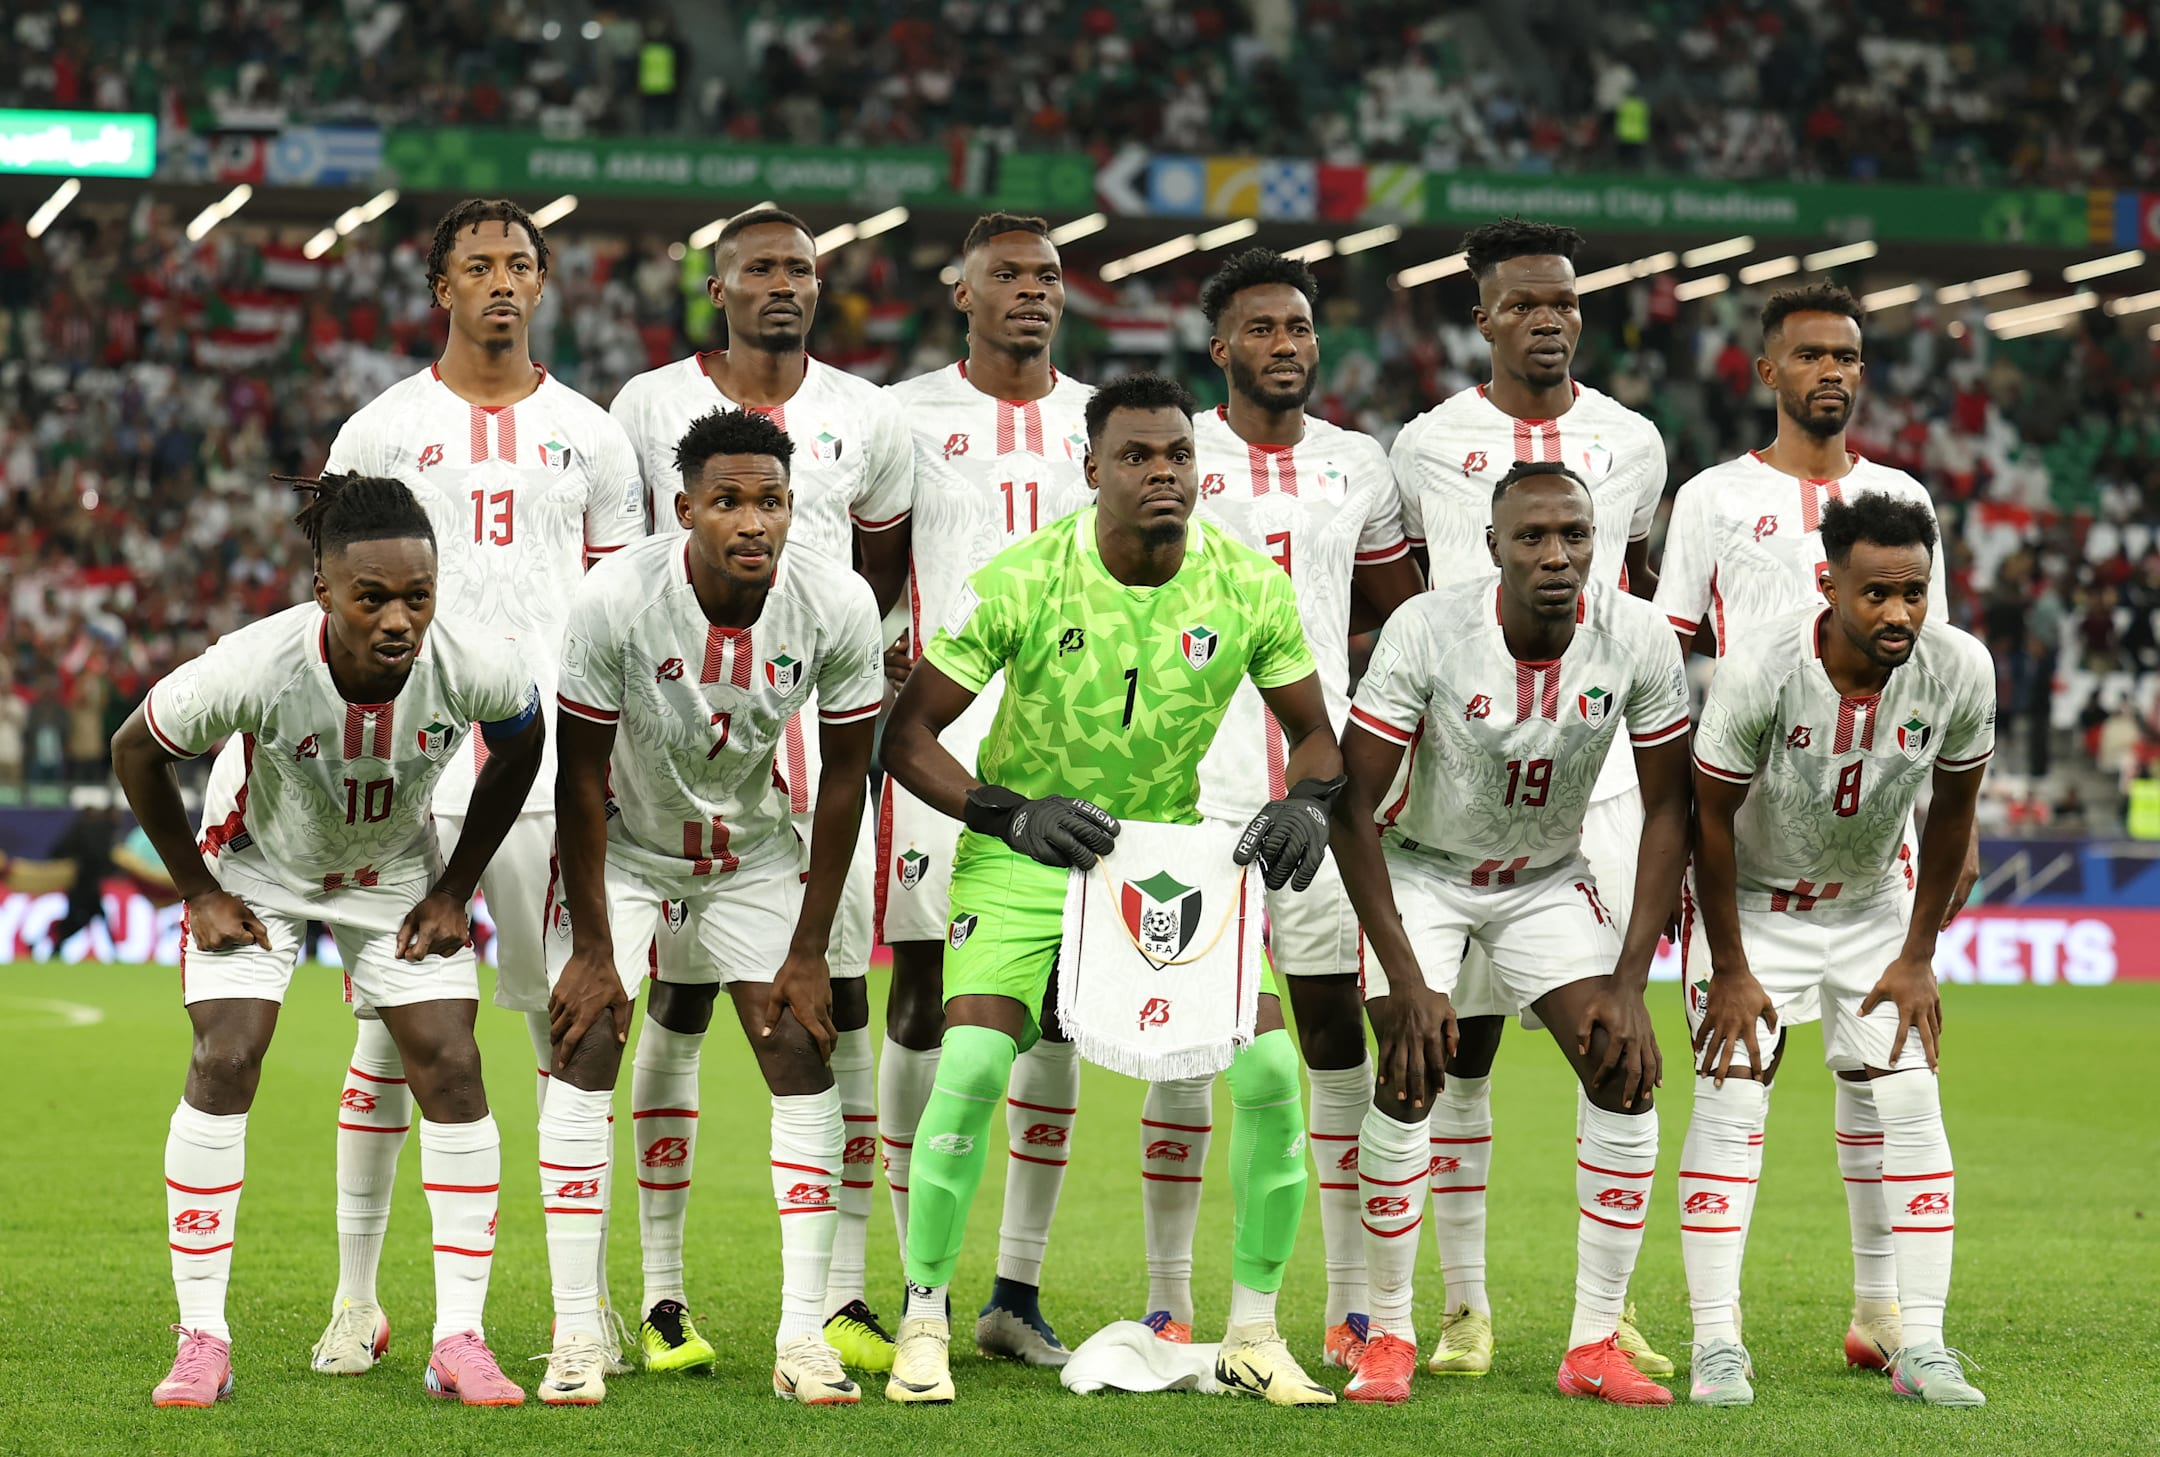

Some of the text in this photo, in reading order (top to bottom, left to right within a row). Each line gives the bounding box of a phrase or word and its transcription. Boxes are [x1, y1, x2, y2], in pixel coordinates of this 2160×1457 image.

[471, 490, 513, 547] 13
[1000, 481, 1038, 535] 11
[1122, 667, 1138, 730] 1
[706, 712, 731, 760] 7
[344, 777, 394, 825] 10
[1504, 758, 1553, 808] 19
[1833, 760, 1863, 817] 8
[1072, 798, 1116, 829] REIGN
[1238, 814, 1270, 855] REIGN
